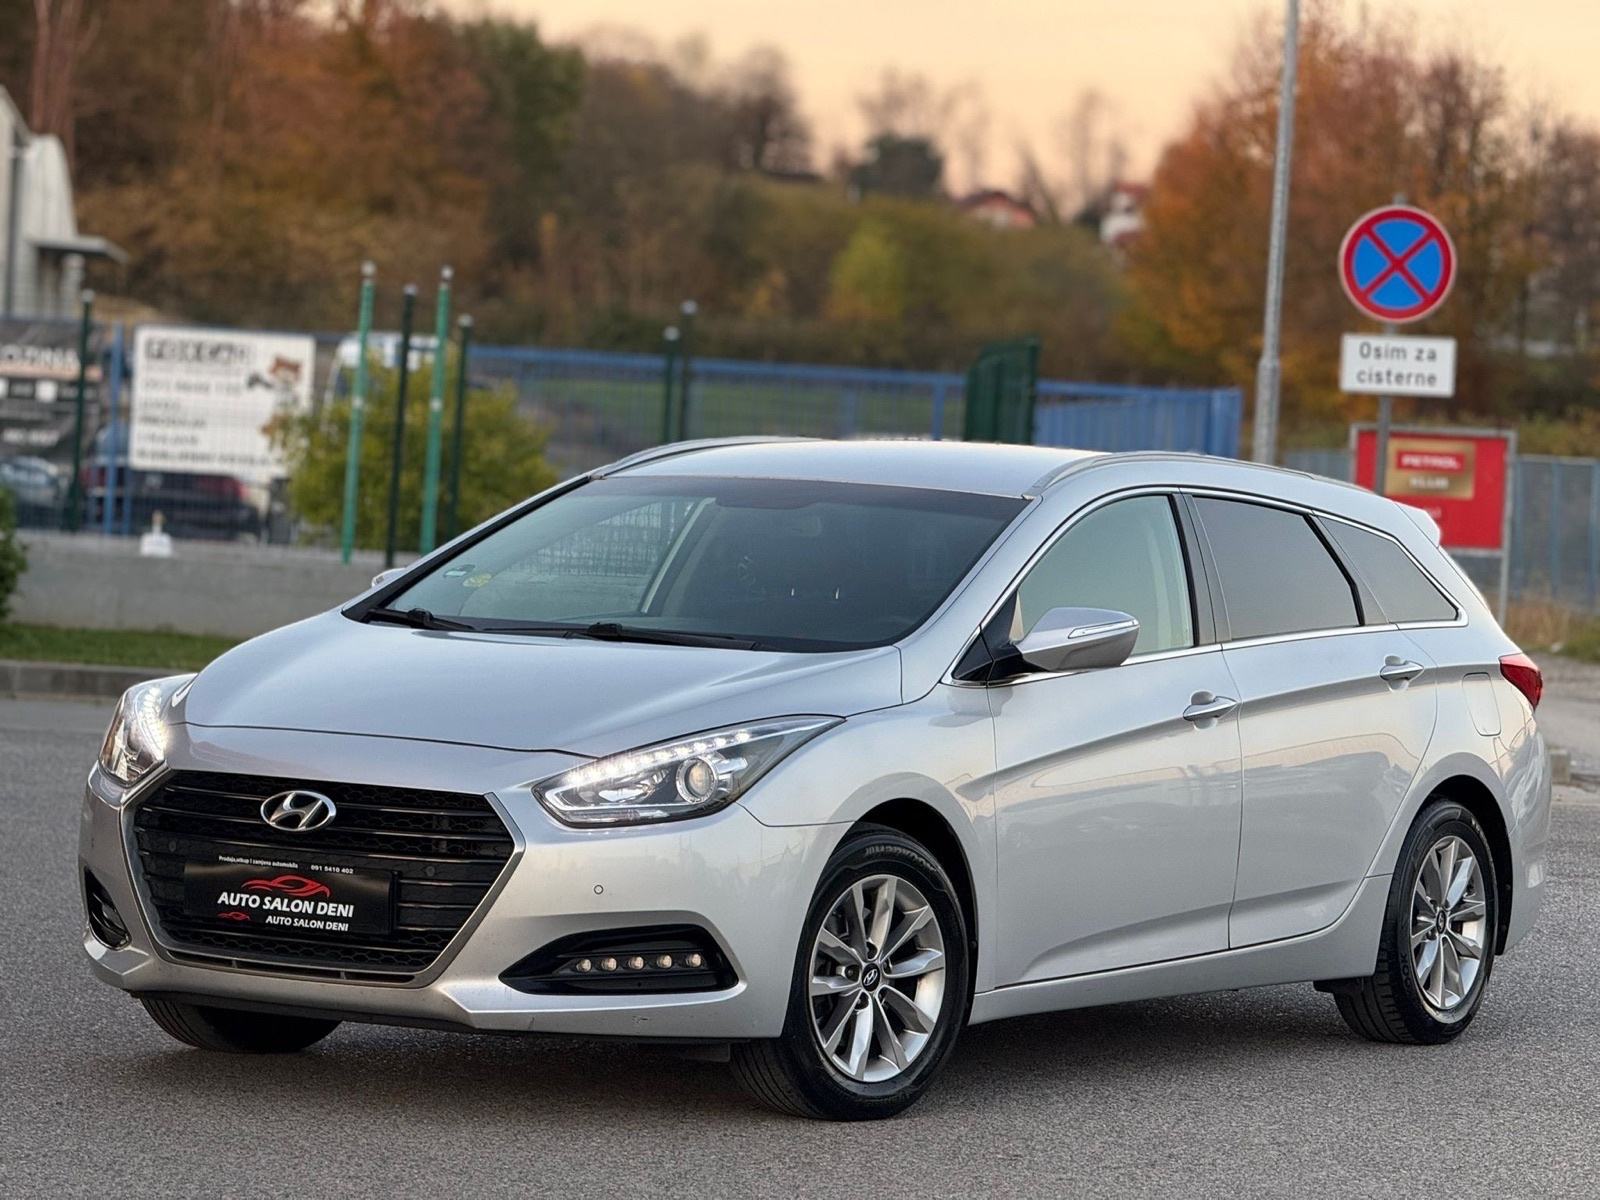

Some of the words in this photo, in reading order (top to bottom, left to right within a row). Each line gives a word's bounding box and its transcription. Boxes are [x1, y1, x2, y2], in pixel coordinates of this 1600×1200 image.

[1360, 341, 1407, 360] Osim
[1415, 347, 1437, 362] za
[1356, 366, 1437, 387] cisterne
[311, 864, 322, 872] 091
[217, 891, 260, 908] AUTO
[262, 896, 314, 915] SALON
[316, 902, 355, 918] DENI
[265, 915, 292, 926] AUTO
[293, 918, 324, 929] SALON
[325, 922, 349, 932] DENI
